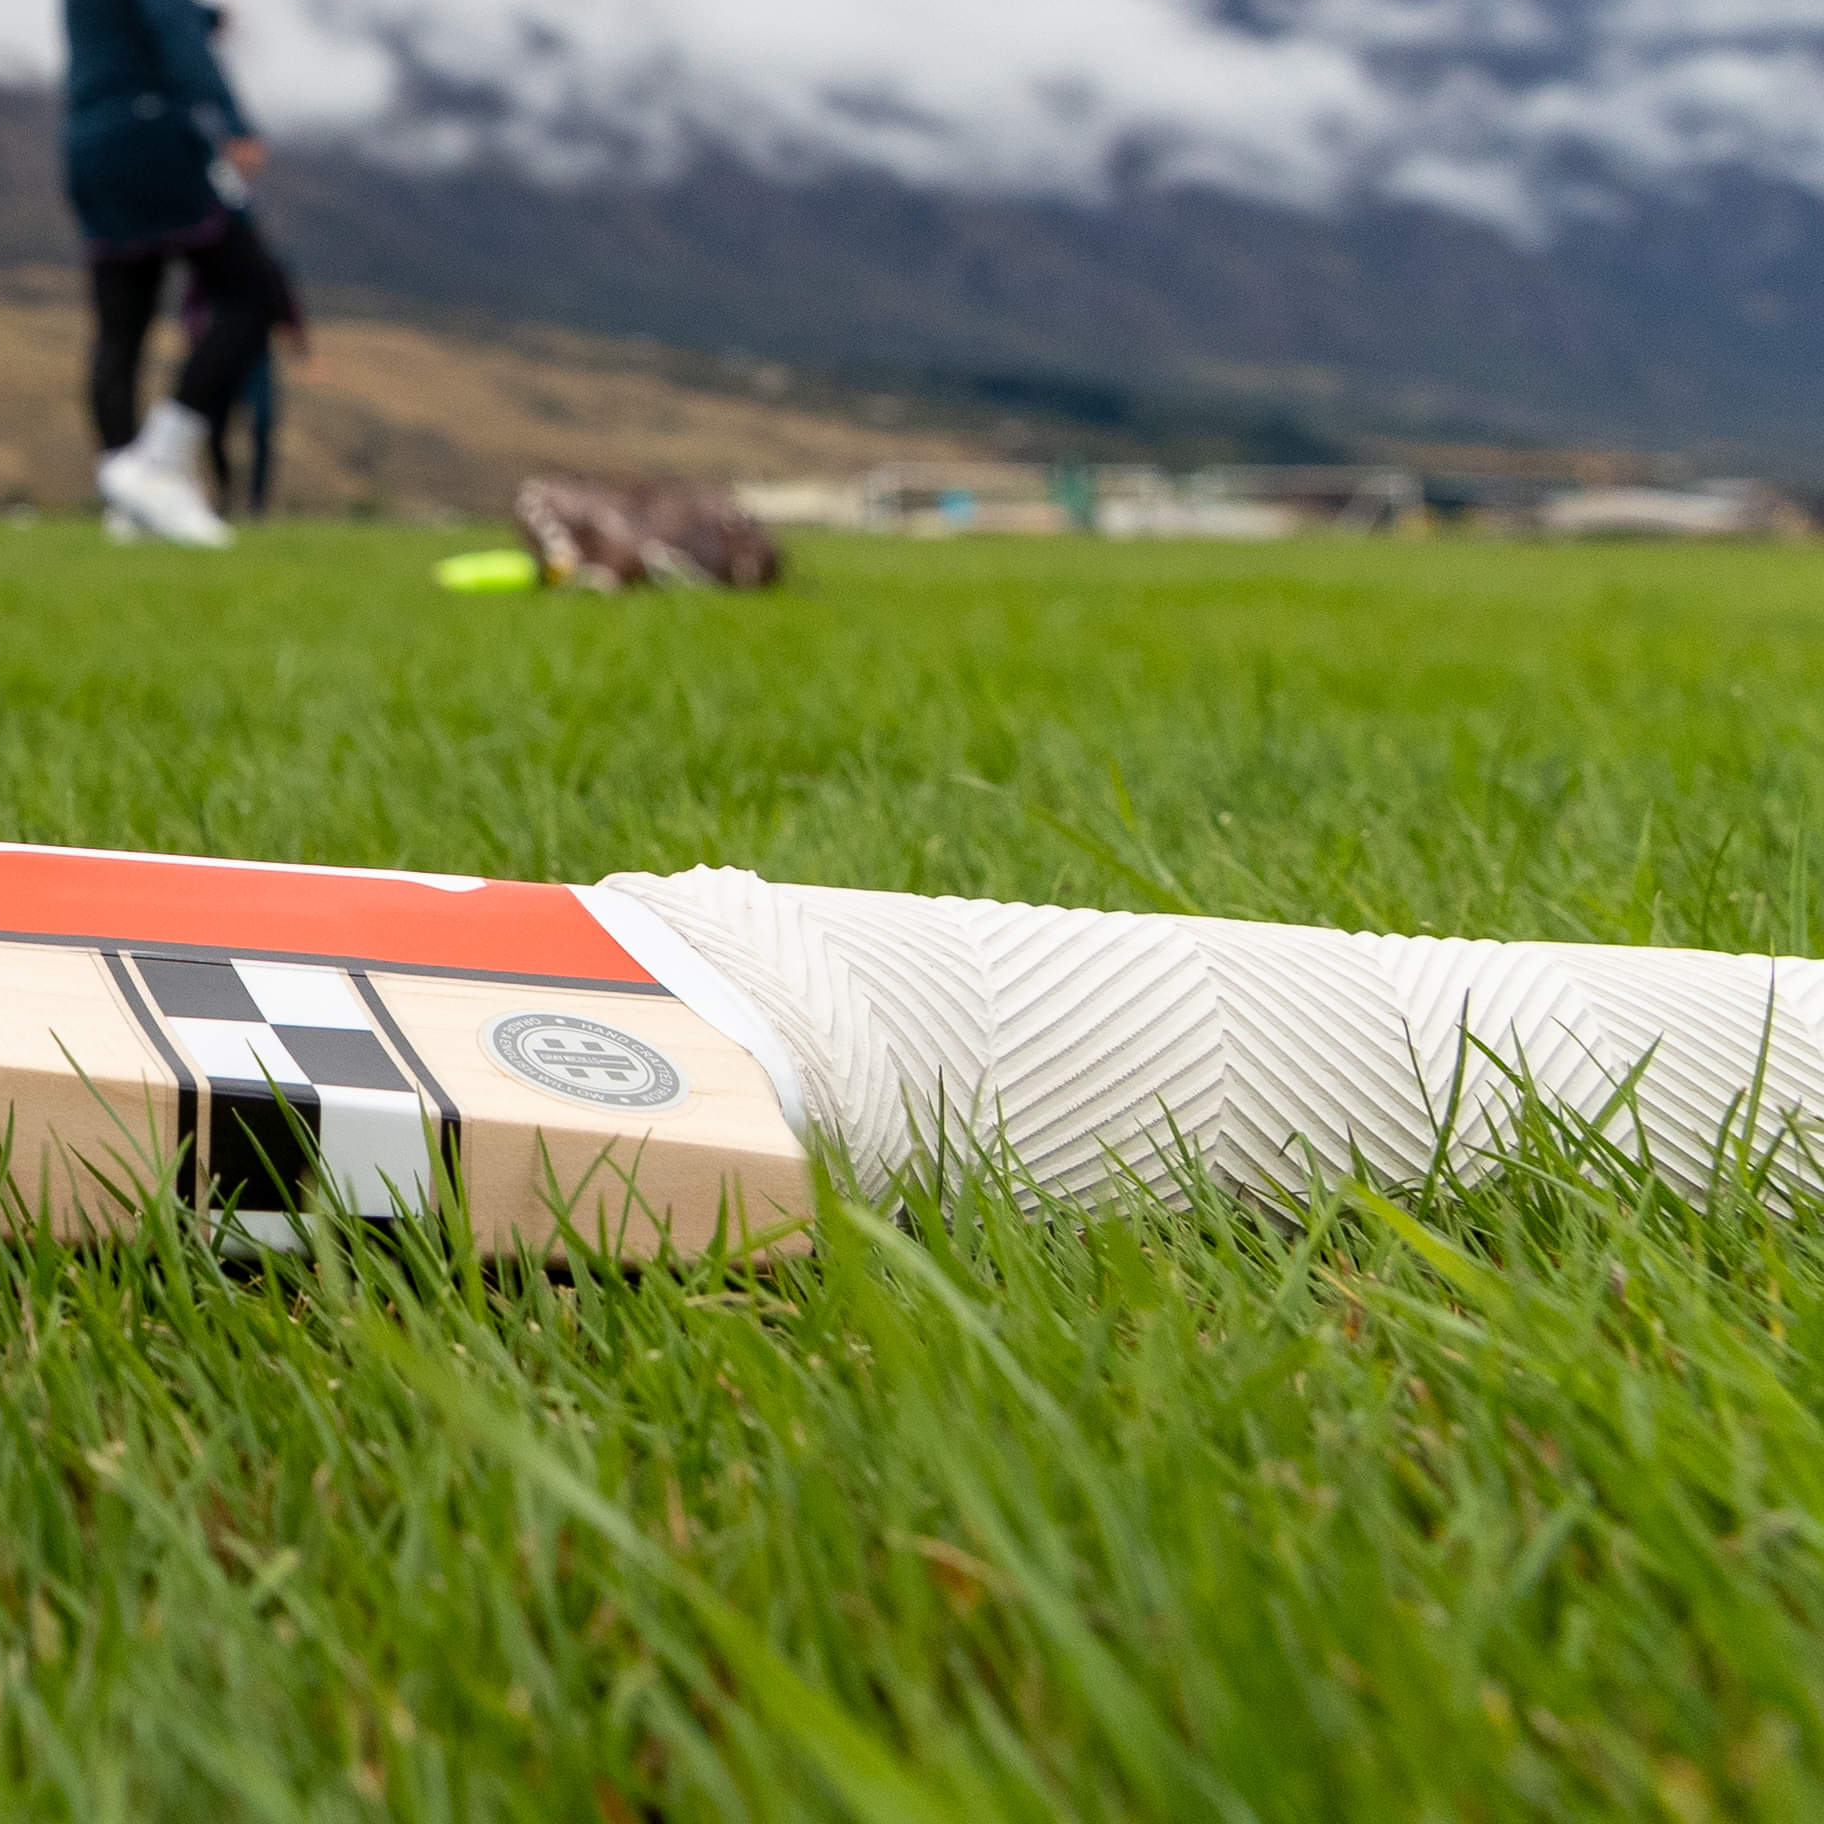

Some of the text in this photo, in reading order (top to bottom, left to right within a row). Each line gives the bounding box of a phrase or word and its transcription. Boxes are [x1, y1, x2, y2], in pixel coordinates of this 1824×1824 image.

[580, 1022, 630, 1045] HAND
[631, 1043, 673, 1087] CRAFTED
[537, 1075, 606, 1101] WILLOW
